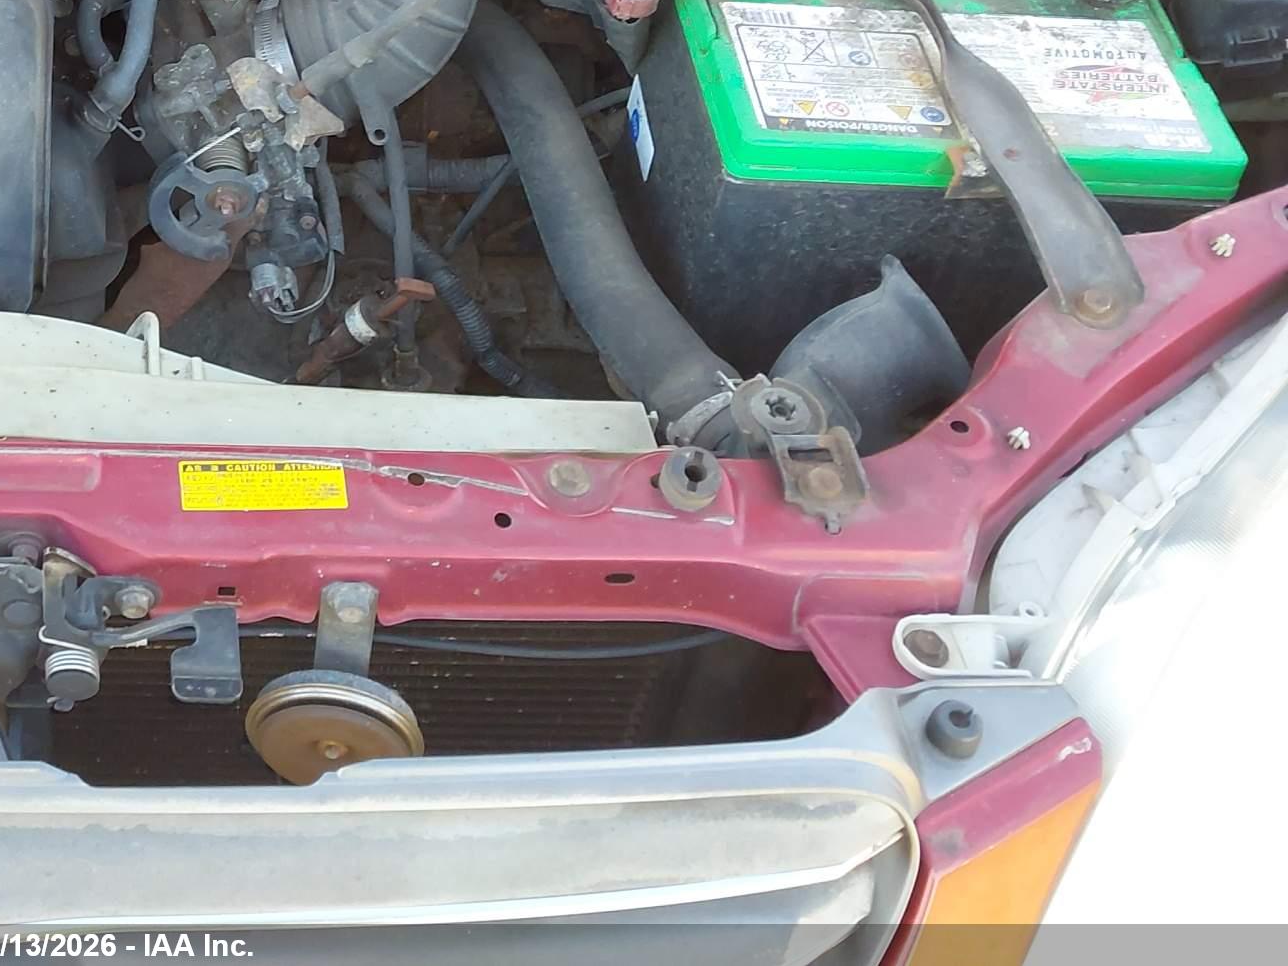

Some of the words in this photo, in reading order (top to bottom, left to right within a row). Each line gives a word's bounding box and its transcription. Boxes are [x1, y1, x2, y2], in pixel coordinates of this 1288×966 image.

[1043, 48, 1147, 61] AUTOMOTIVE
[1054, 70, 1159, 83] BATTERIES
[1054, 79, 1169, 94] INTERSTATE
[805, 119, 919, 134] DANGER/POISON
[226, 463, 276, 471] CAUTION
